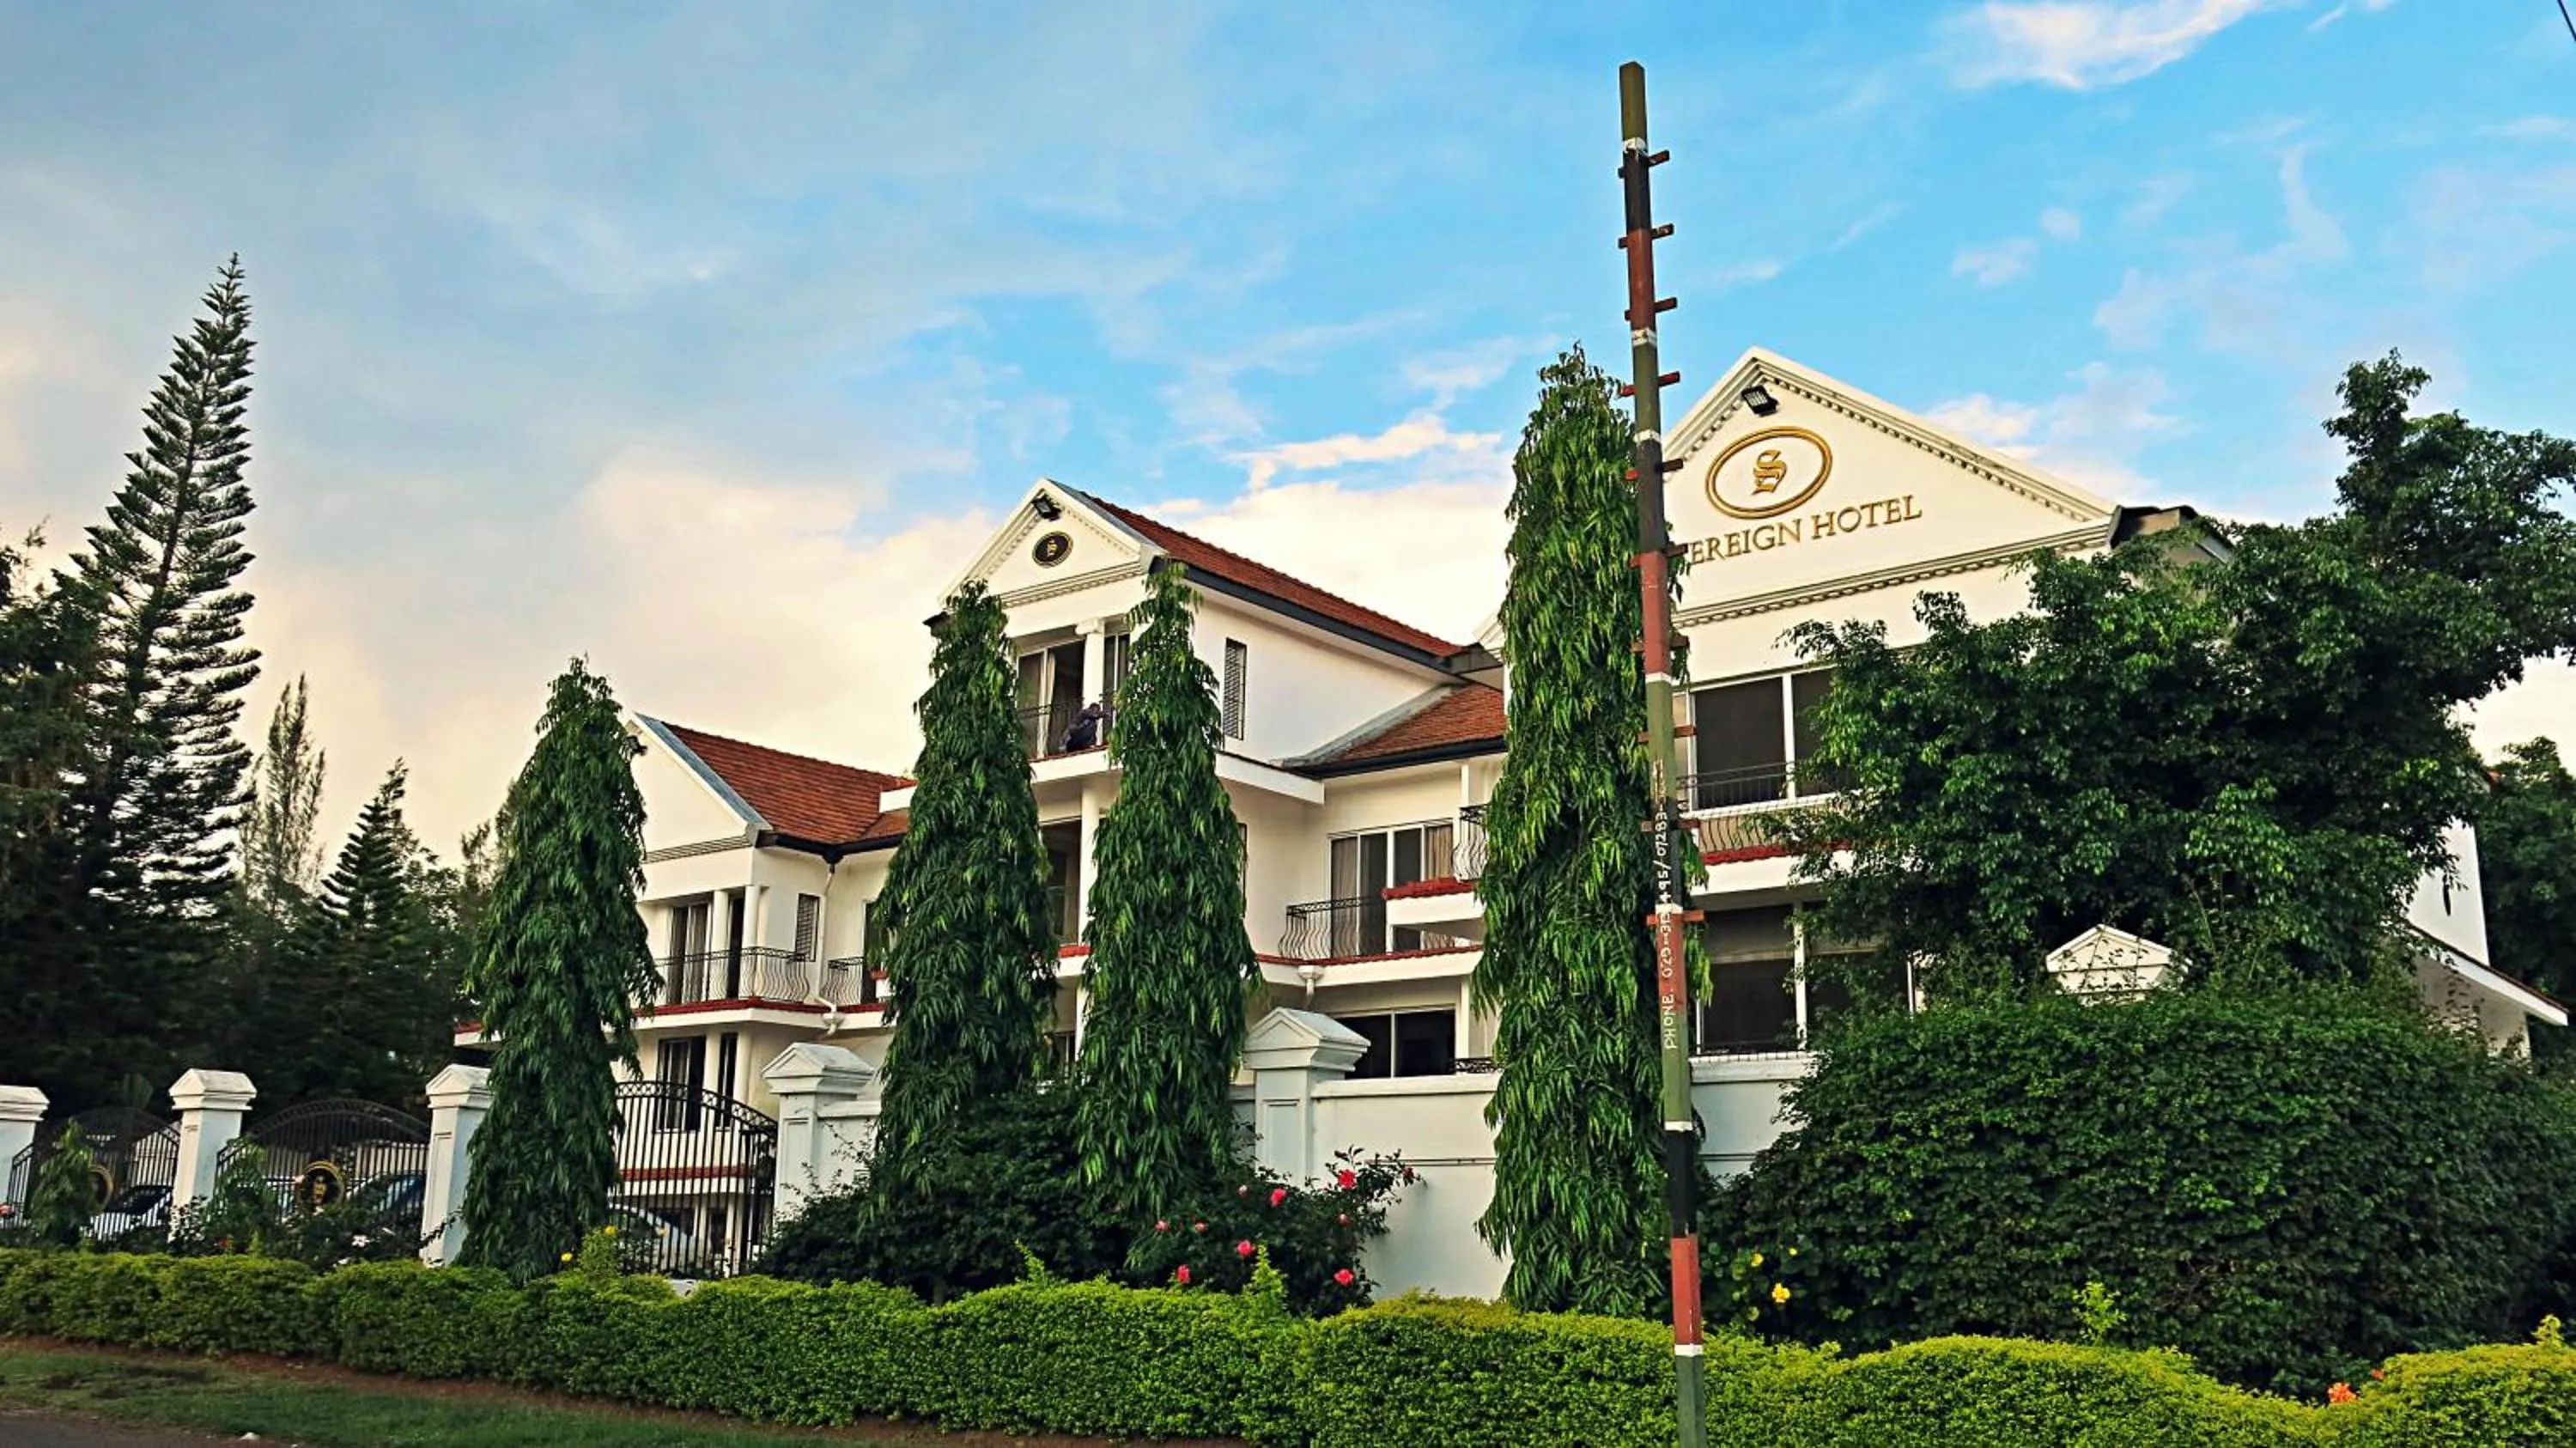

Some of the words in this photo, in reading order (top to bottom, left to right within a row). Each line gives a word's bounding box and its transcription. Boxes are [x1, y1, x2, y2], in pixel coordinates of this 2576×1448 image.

[1752, 449, 1788, 496] S
[1688, 518, 1801, 565] EREIGN
[1811, 494, 1923, 539] HOTEL
